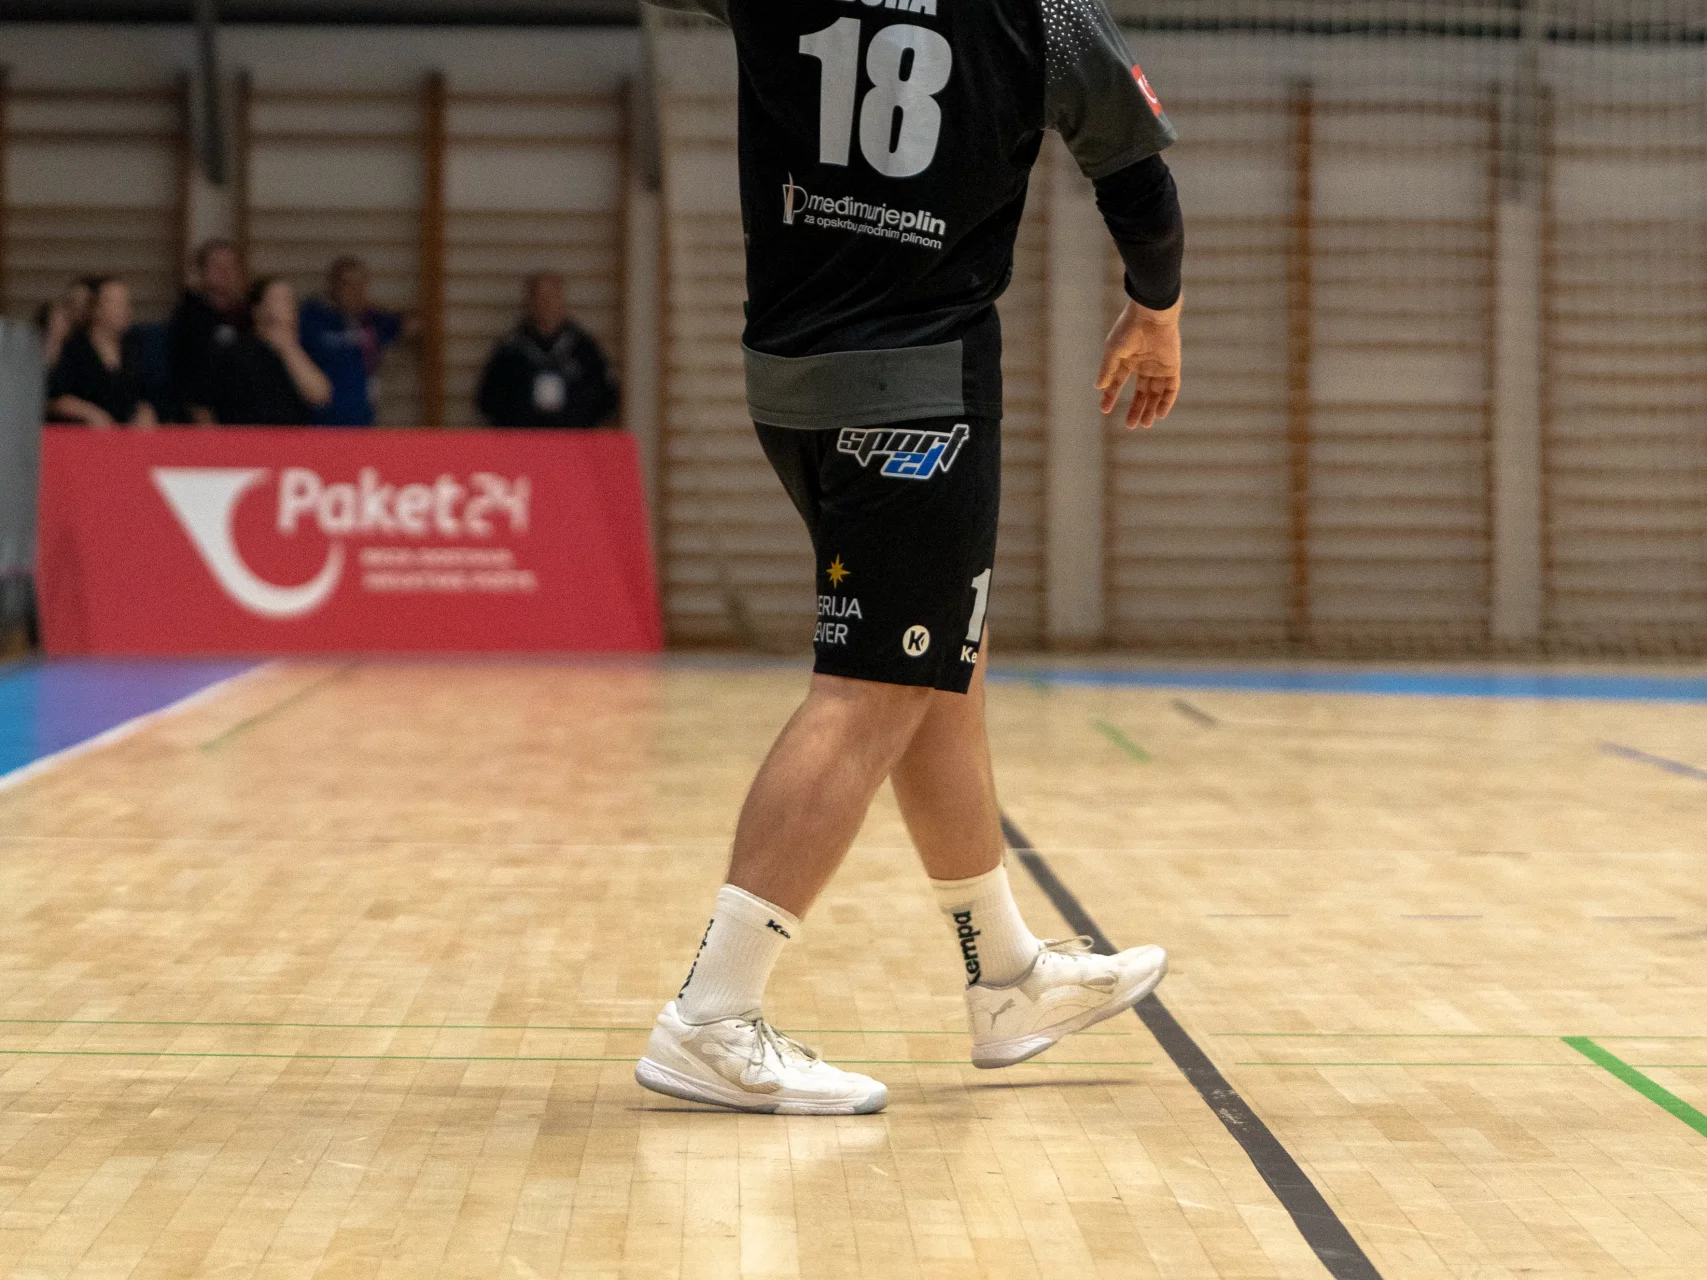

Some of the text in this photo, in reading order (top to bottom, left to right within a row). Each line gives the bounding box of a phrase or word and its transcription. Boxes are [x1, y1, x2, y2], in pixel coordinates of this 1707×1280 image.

[799, 16, 952, 179] 18
[804, 214, 815, 224] za
[817, 216, 857, 231] opskrbu
[901, 232, 942, 250] plinom
[837, 423, 969, 472] sport
